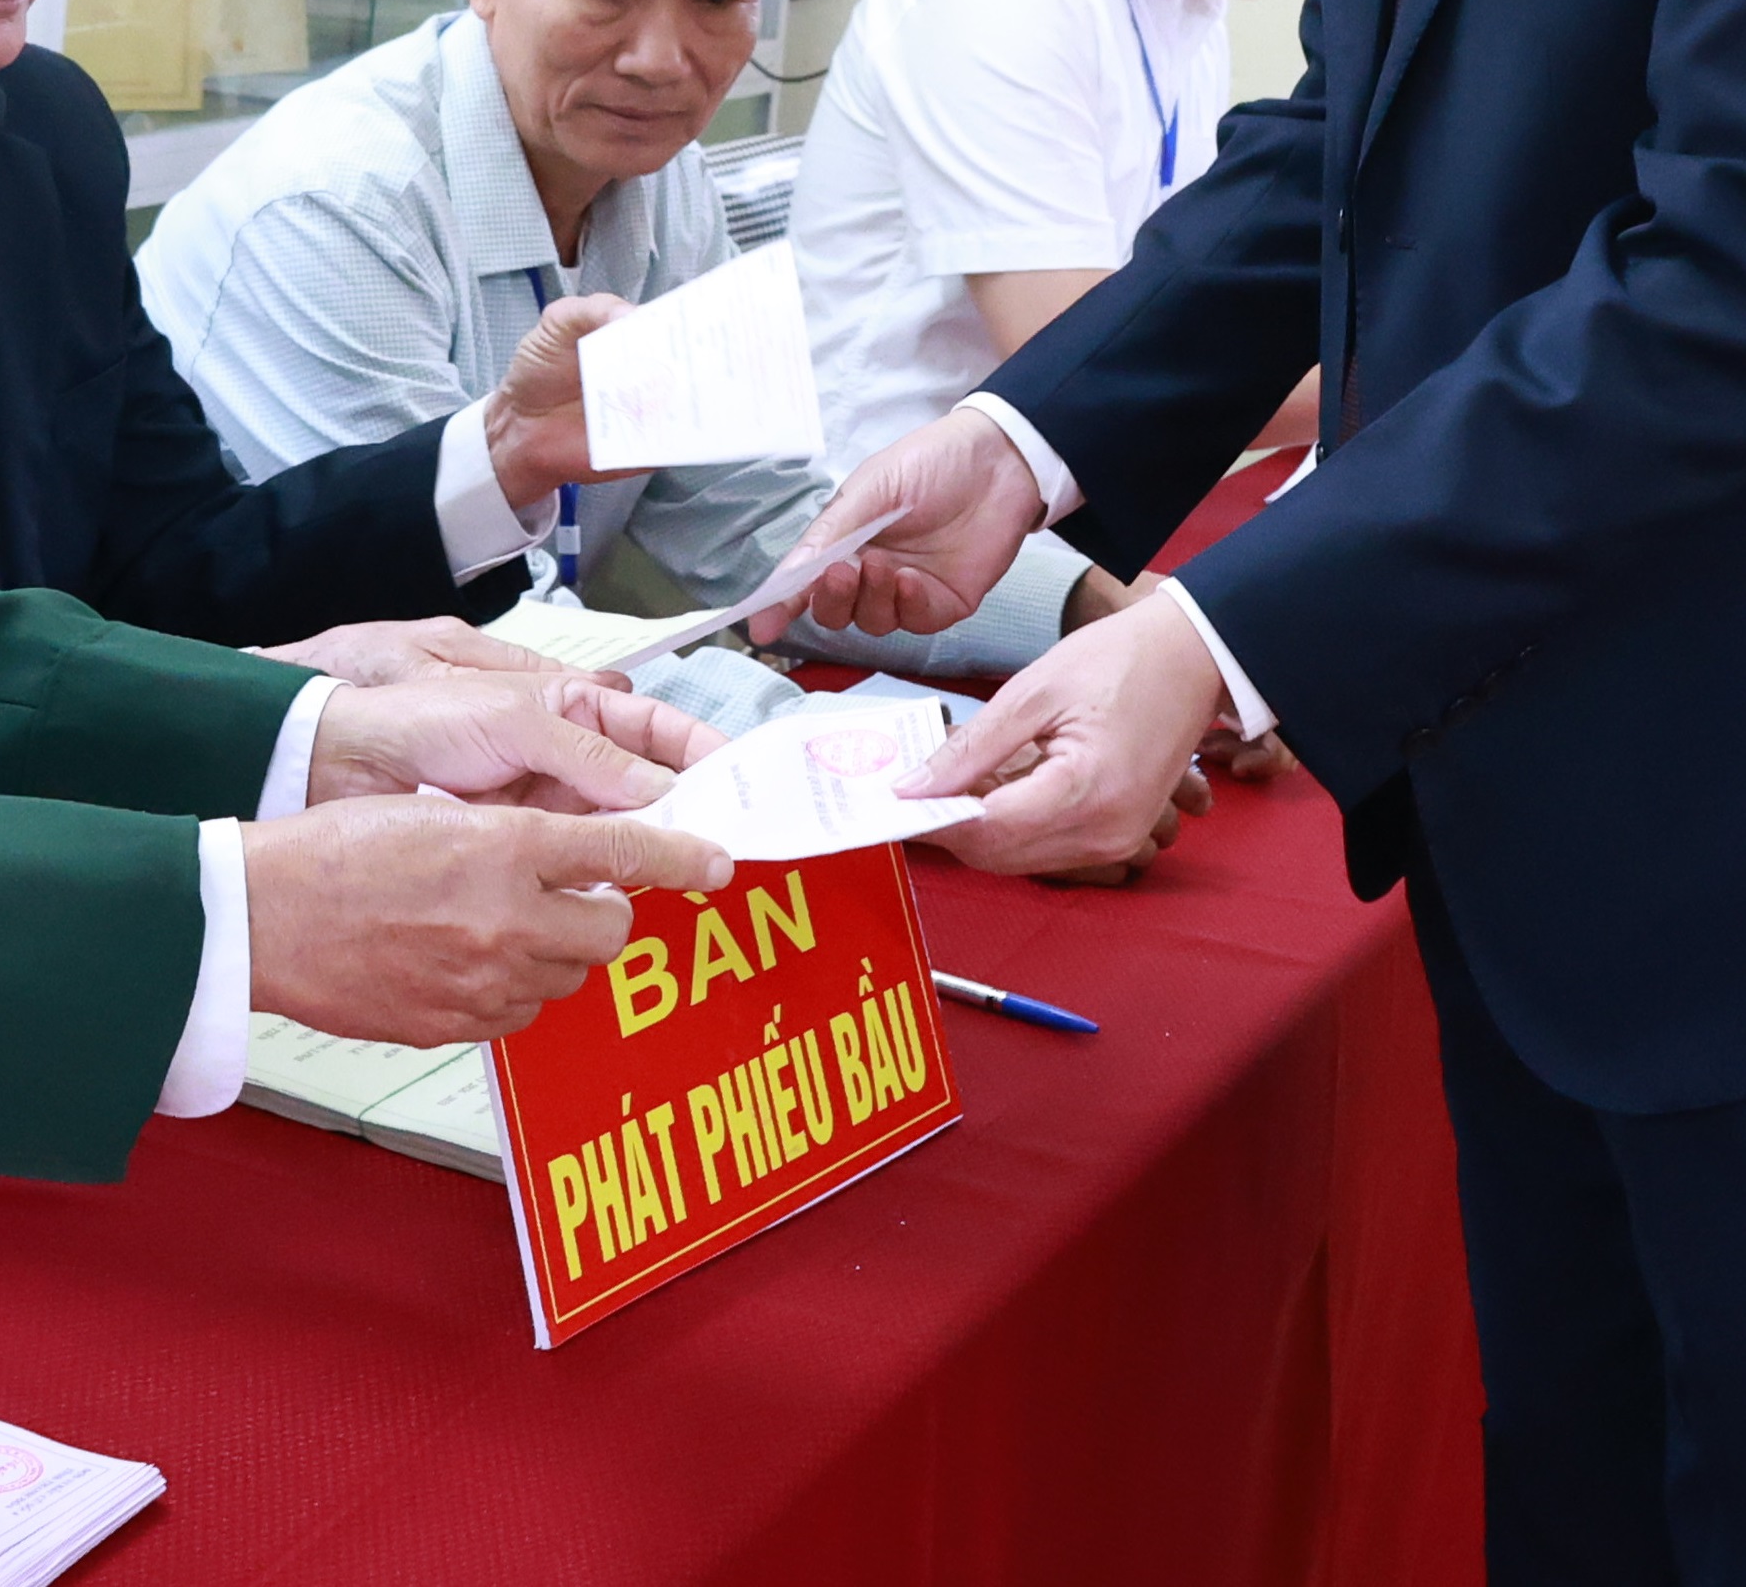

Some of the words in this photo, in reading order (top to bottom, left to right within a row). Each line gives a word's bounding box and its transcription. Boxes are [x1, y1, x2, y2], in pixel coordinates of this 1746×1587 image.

[607, 870, 816, 1039] BÀN
[548, 1093, 687, 1281] PHÁT
[687, 1004, 834, 1204] PHIẾU
[829, 957, 928, 1127] BẦU
